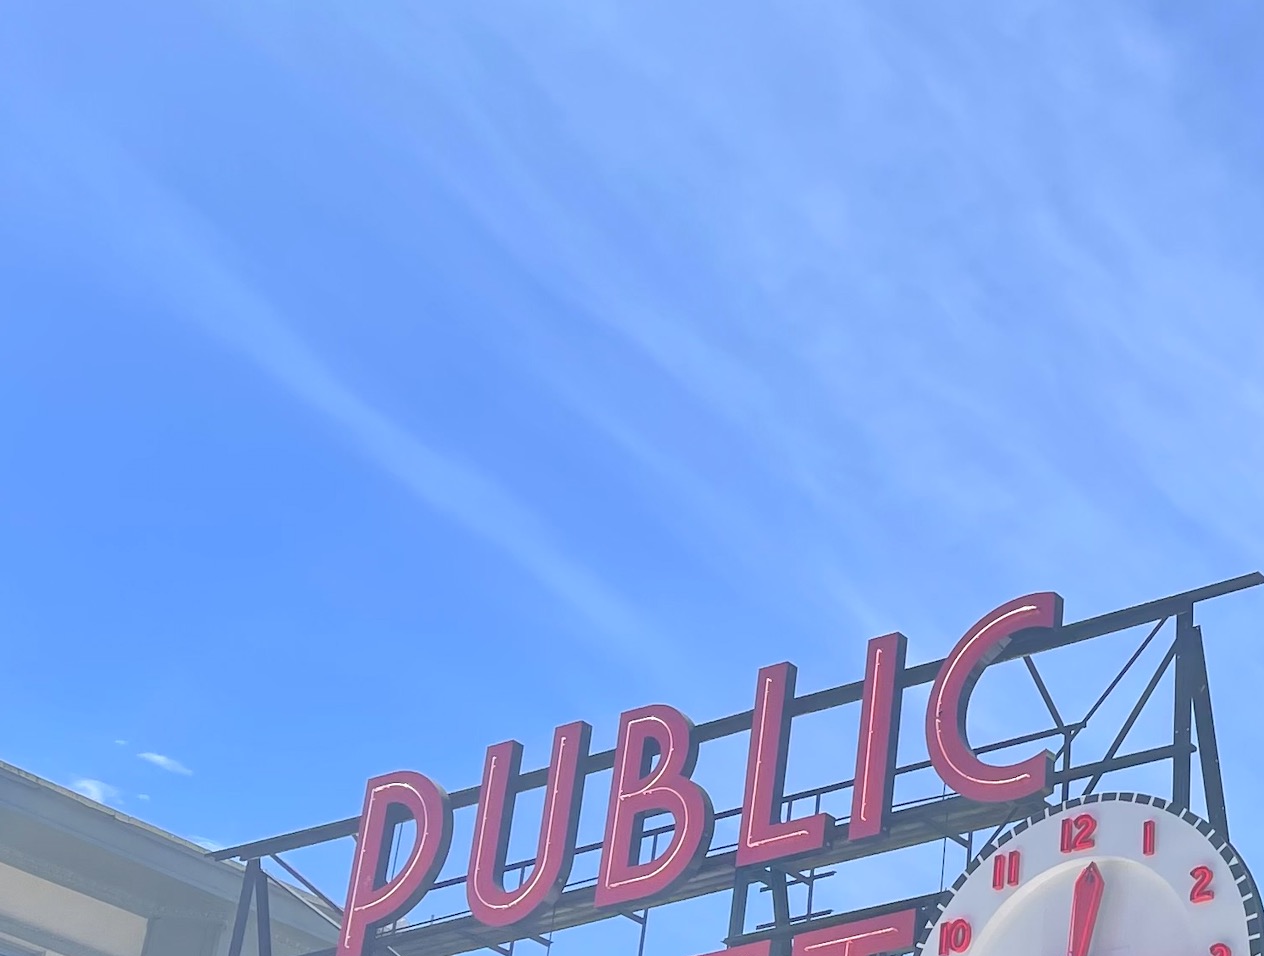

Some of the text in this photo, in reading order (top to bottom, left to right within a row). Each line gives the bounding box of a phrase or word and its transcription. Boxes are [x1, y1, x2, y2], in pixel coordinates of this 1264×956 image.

[1059, 813, 1098, 854] 12
[1142, 819, 1156, 856] 1
[991, 849, 1021, 891] 11
[1189, 865, 1214, 903] 2
[938, 917, 972, 956] 10
